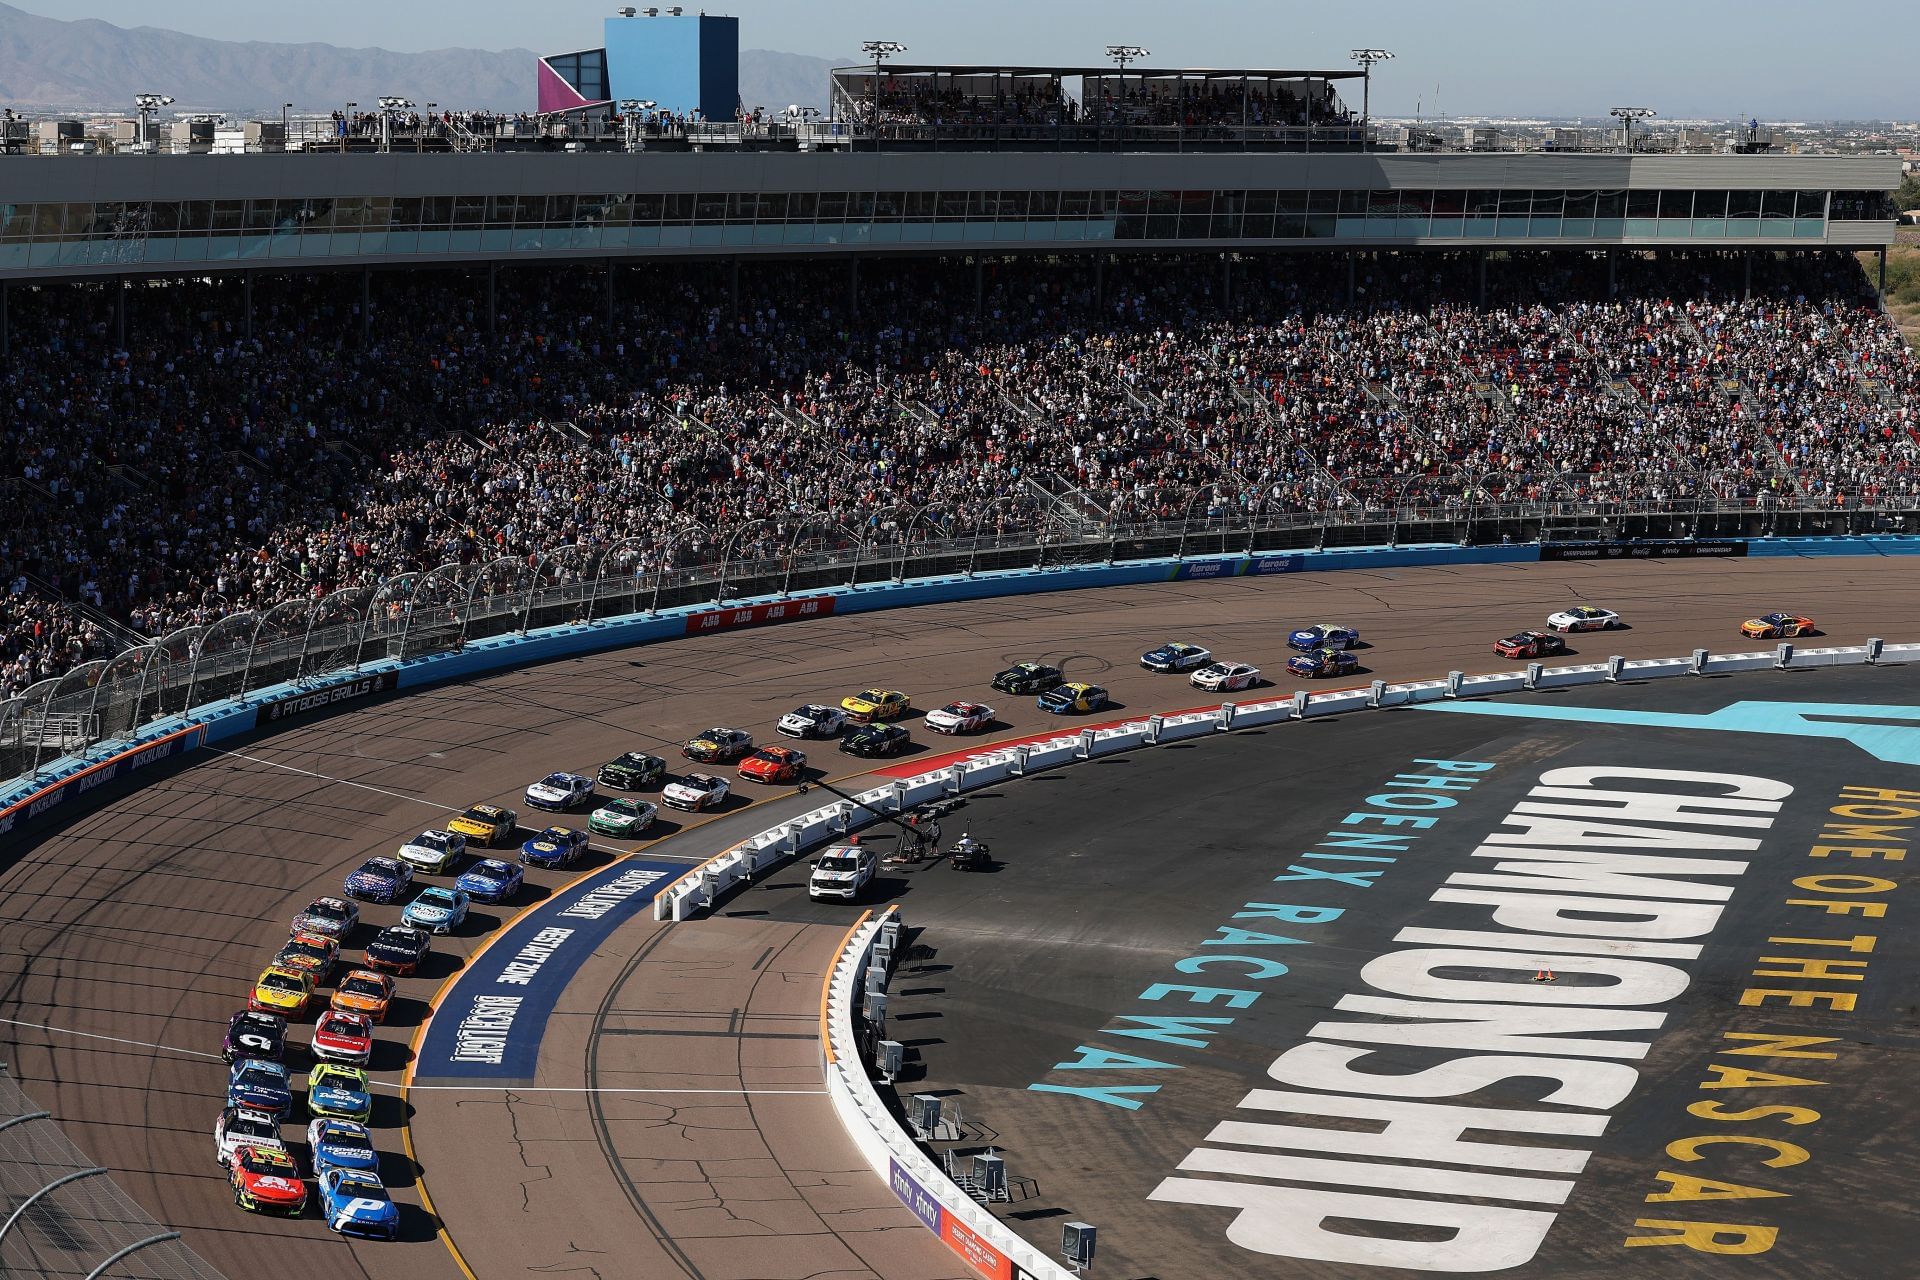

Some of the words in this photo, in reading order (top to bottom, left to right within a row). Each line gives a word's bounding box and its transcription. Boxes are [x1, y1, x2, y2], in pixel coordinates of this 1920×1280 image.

[1189, 563, 1221, 573] Aaron's
[1258, 559, 1290, 569] Aaron's
[701, 614, 720, 628] ABB
[733, 611, 753, 624] ABB
[766, 605, 785, 618] ABB
[799, 601, 819, 614] ABB
[1324, 638, 1333, 647] 66
[283, 699, 301, 716] PIT
[300, 692, 330, 711] BOSS
[331, 681, 371, 702] GRILLS
[594, 815, 623, 827] Castrol
[1273, 758, 1496, 887] PHOENIX
[1809, 786, 1920, 860] HOME
[1785, 874, 1898, 918] OF
[516, 926, 576, 965] RESTART
[496, 961, 541, 986] ZONE
[1738, 936, 1878, 1012] THE
[1026, 902, 1346, 1111] RACEWAY
[1146, 766, 1794, 1273] CHAMPIONSHIP
[319, 1035, 364, 1047] Motorcraft
[1623, 1032, 1844, 1256] NASCAR
[252, 1182, 298, 1194] AXALTA
[893, 1169, 913, 1204] xfinity
[915, 1191, 937, 1227] xfinity
[952, 1225, 965, 1243] DESERT
[964, 1236, 982, 1256] DIAMOND
[982, 1250, 997, 1267] CASINO
